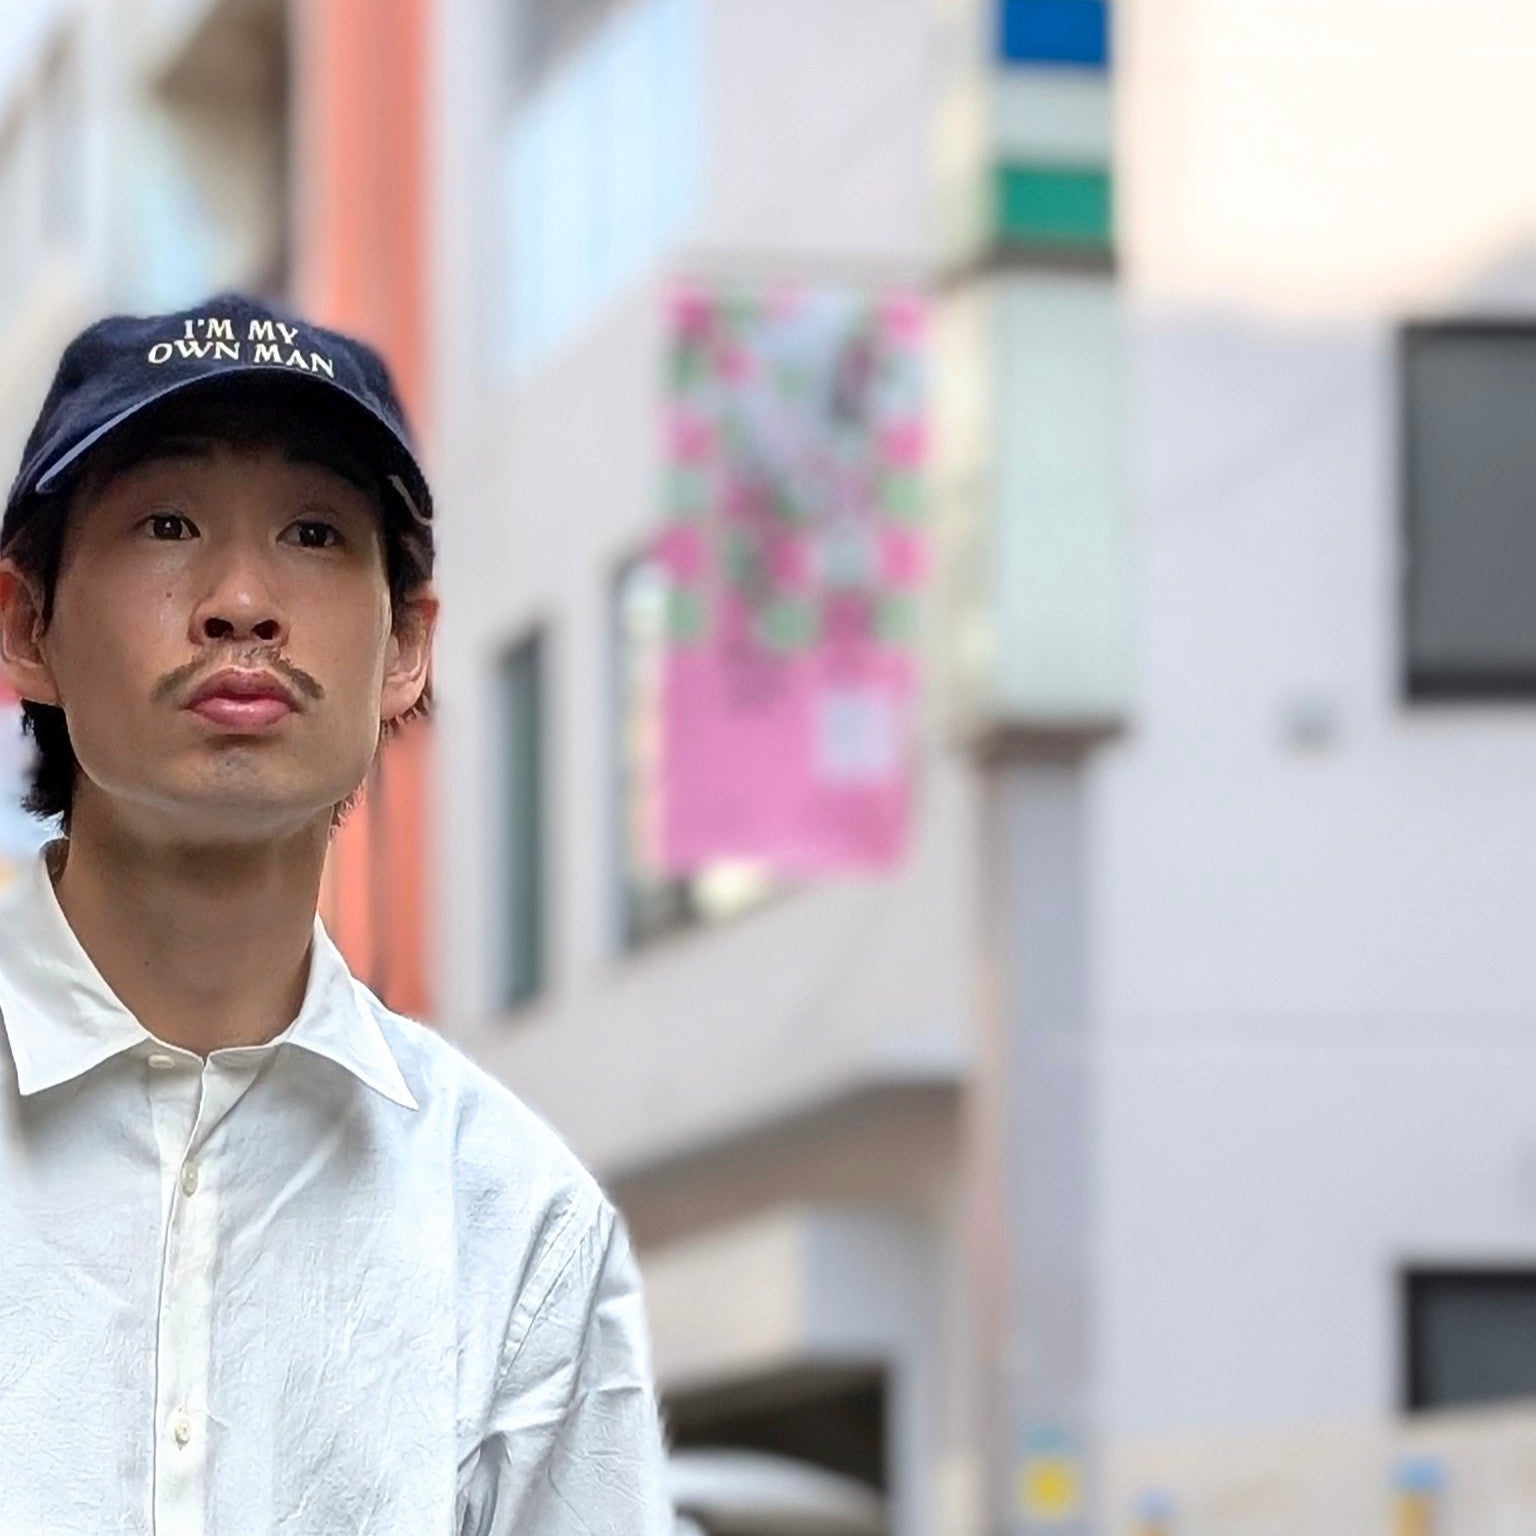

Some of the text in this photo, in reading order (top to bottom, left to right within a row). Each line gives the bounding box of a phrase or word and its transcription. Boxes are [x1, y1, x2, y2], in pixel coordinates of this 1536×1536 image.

[183, 318, 299, 345] I'M MY
[147, 339, 335, 379] OWN MAN
